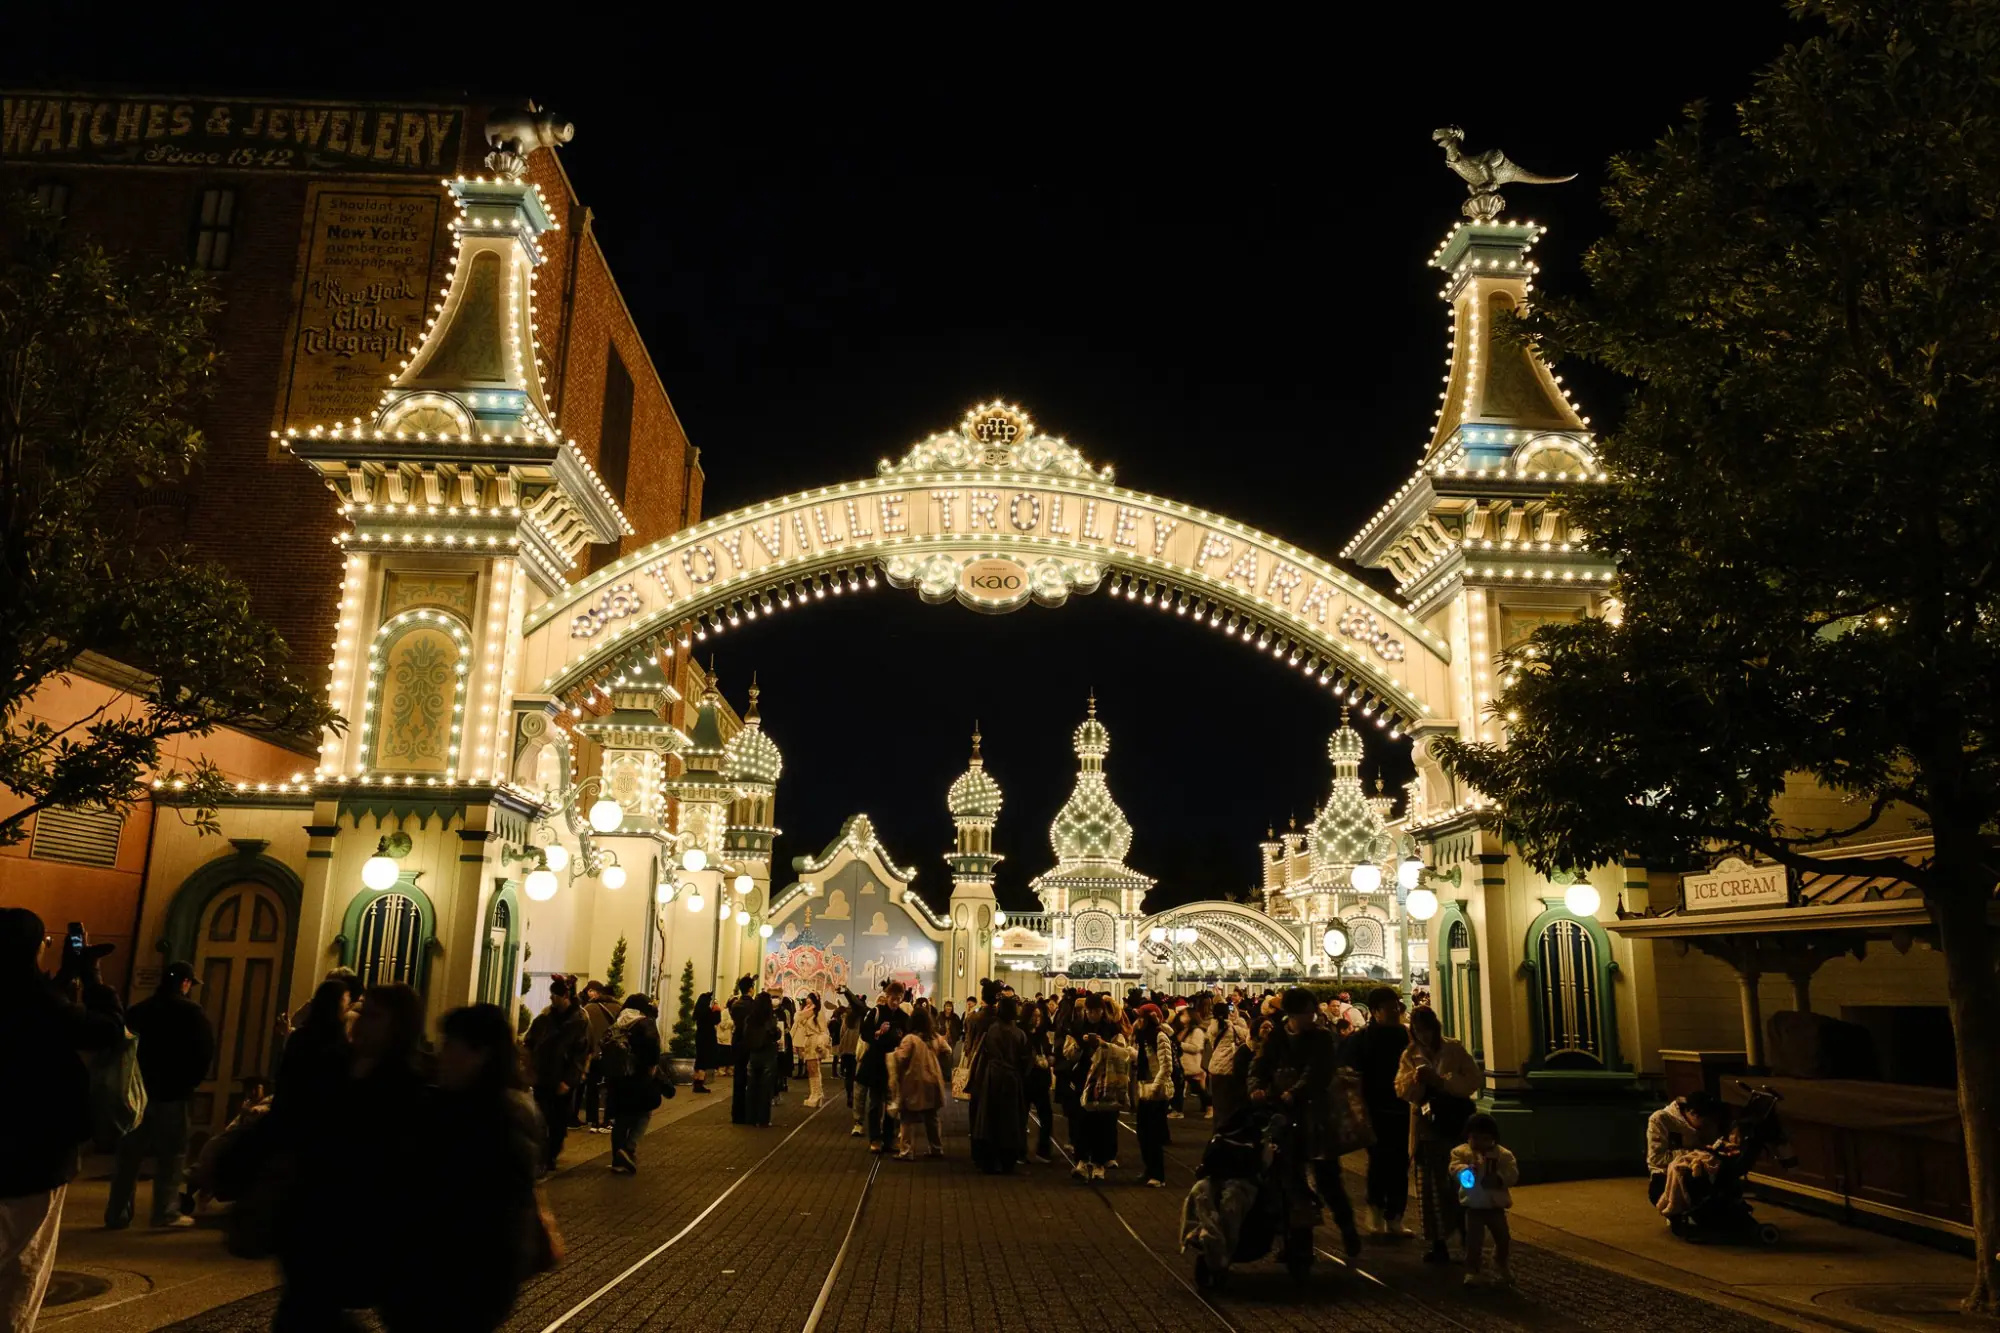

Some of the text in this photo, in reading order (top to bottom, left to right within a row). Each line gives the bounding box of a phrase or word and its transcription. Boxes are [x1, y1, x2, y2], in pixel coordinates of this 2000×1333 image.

[3, 98, 456, 166] WATCHES & JEWELERY
[399, 202, 423, 214] you
[327, 224, 366, 240] New
[326, 275, 416, 308] New York
[333, 306, 397, 331] Globe
[302, 326, 412, 361] Telegraph
[644, 490, 1341, 624] TOYVILLE TROLLEY PARK
[1694, 876, 1777, 900] ICE CREAM
